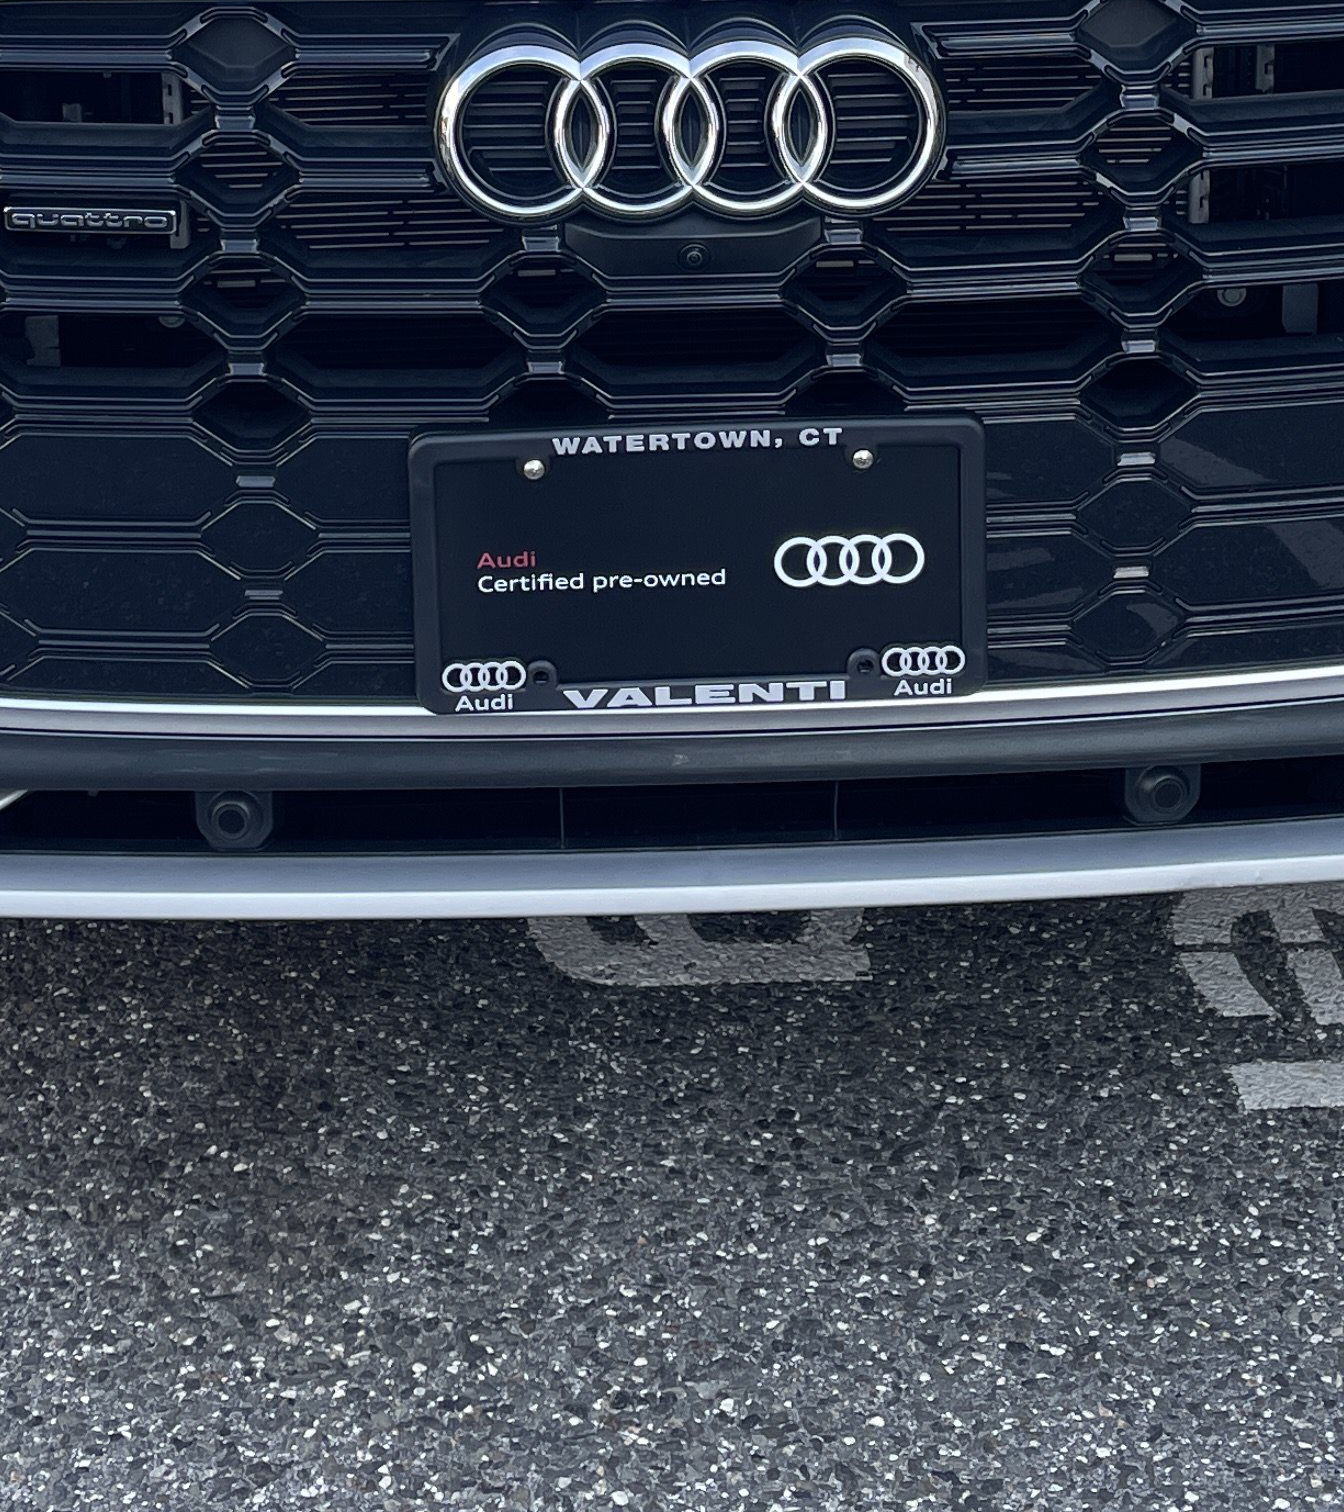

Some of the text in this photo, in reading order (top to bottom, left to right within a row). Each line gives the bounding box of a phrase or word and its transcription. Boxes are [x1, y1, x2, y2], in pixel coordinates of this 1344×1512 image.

[11, 212, 168, 229] quattro
[552, 427, 843, 456] WATERTOWN, CT
[476, 550, 537, 569] Audi
[477, 568, 727, 594] Certified pre-owned
[562, 680, 846, 710] VALENTI
[893, 678, 953, 697] Audi
[455, 693, 514, 713] Audi
